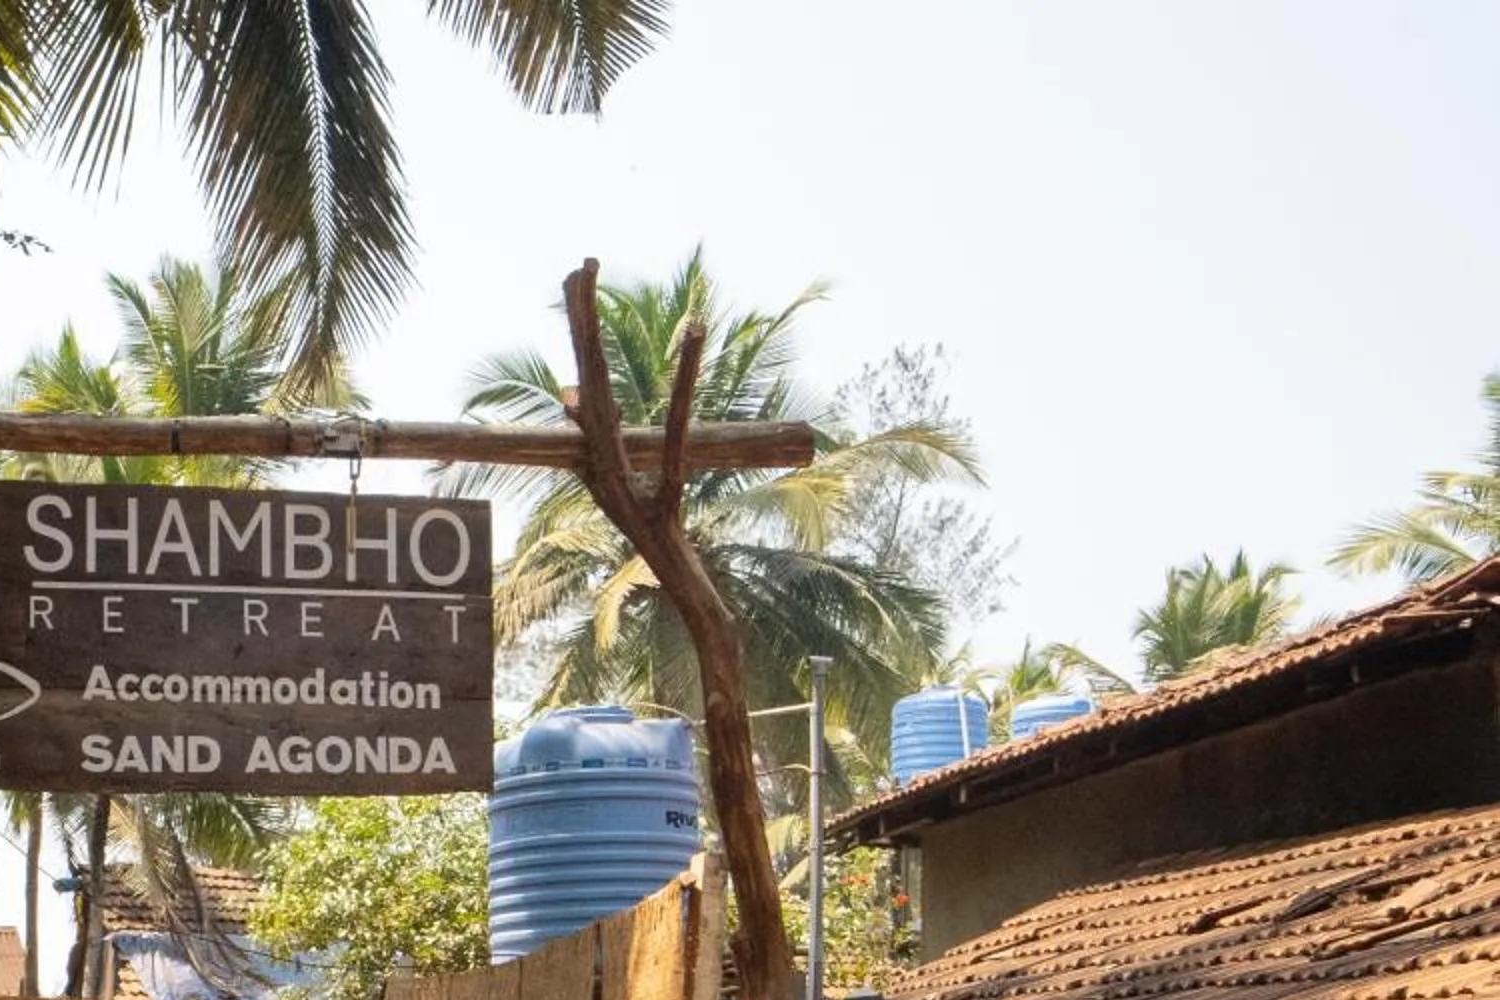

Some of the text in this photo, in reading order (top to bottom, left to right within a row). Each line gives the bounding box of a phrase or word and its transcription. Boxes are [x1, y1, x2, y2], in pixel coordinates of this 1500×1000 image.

[23, 494, 472, 587] SHAMBHO
[29, 595, 468, 644] RETREAT
[82, 664, 442, 709] Accommodation
[81, 734, 458, 775] SAND AGONDA
